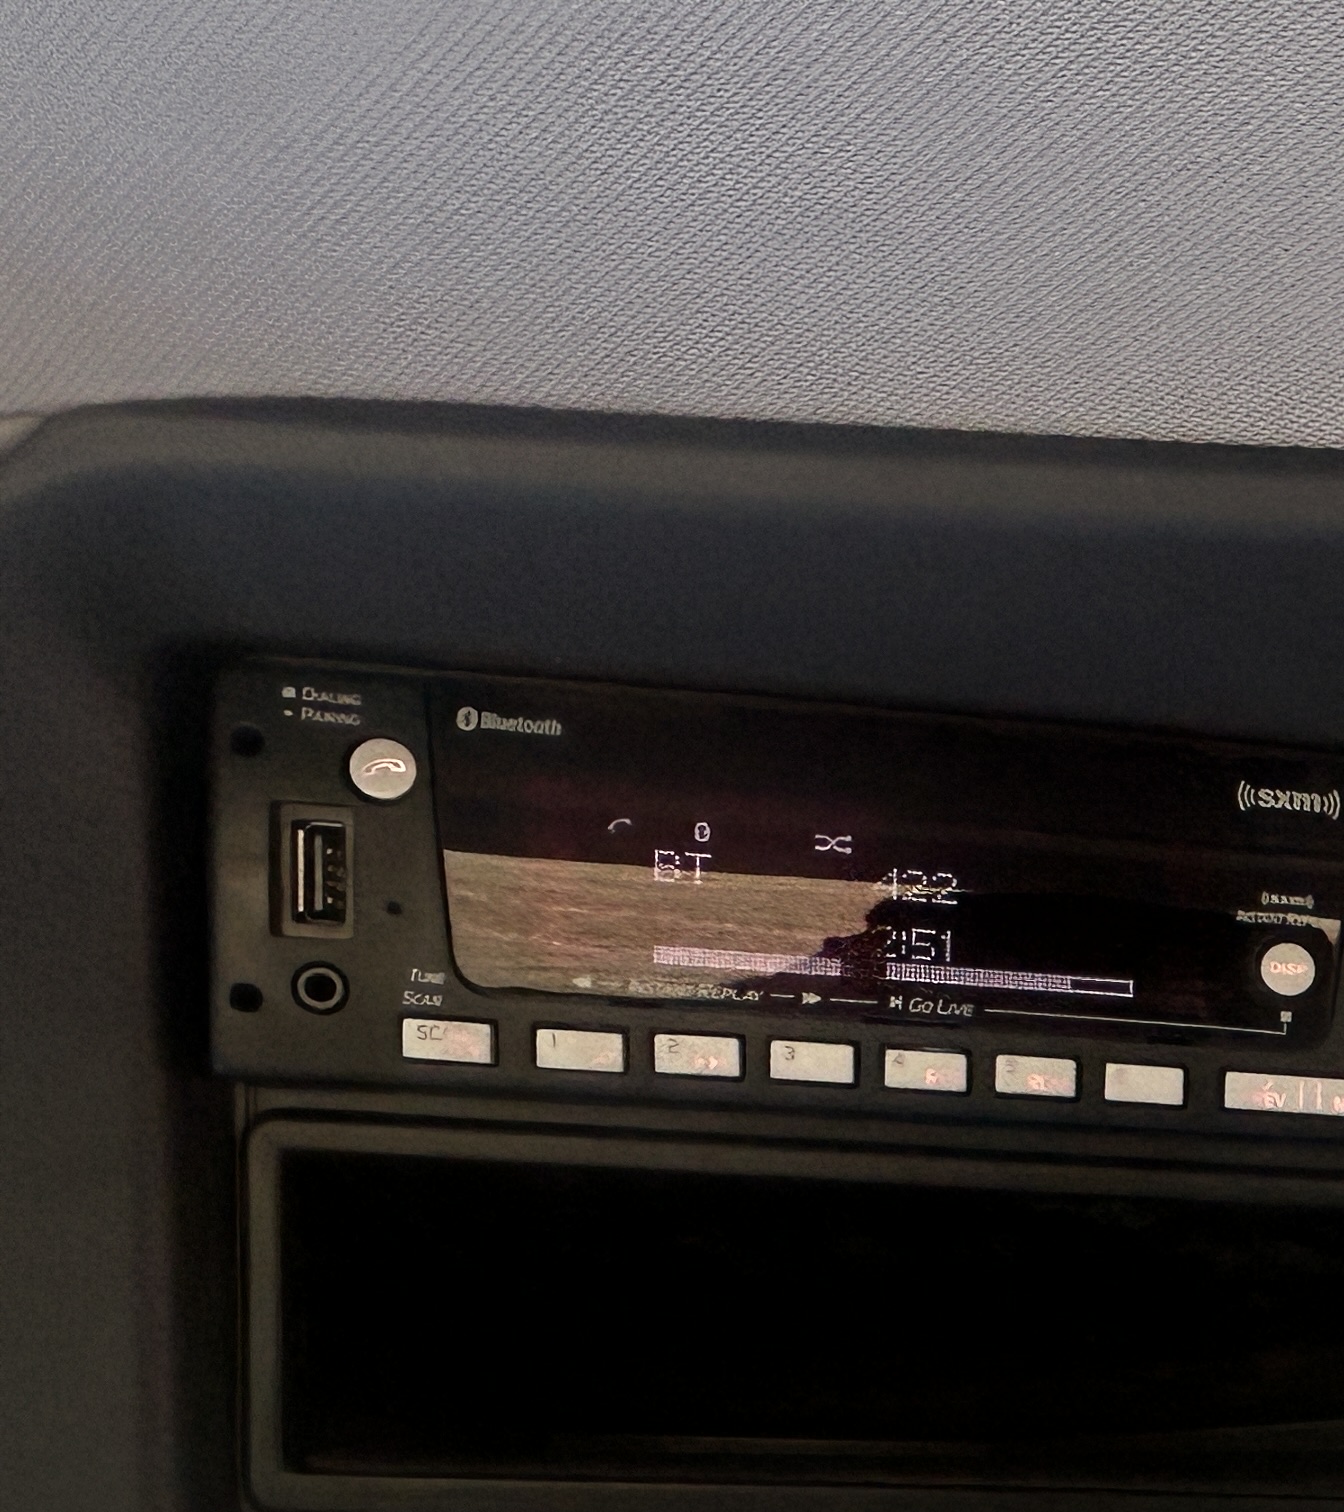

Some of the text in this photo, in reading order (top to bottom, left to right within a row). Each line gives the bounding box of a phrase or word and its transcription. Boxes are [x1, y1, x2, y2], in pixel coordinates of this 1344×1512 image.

[480, 711, 562, 735] Bluetooth
[1269, 961, 1308, 976] DISP
[909, 997, 932, 1015] GO
